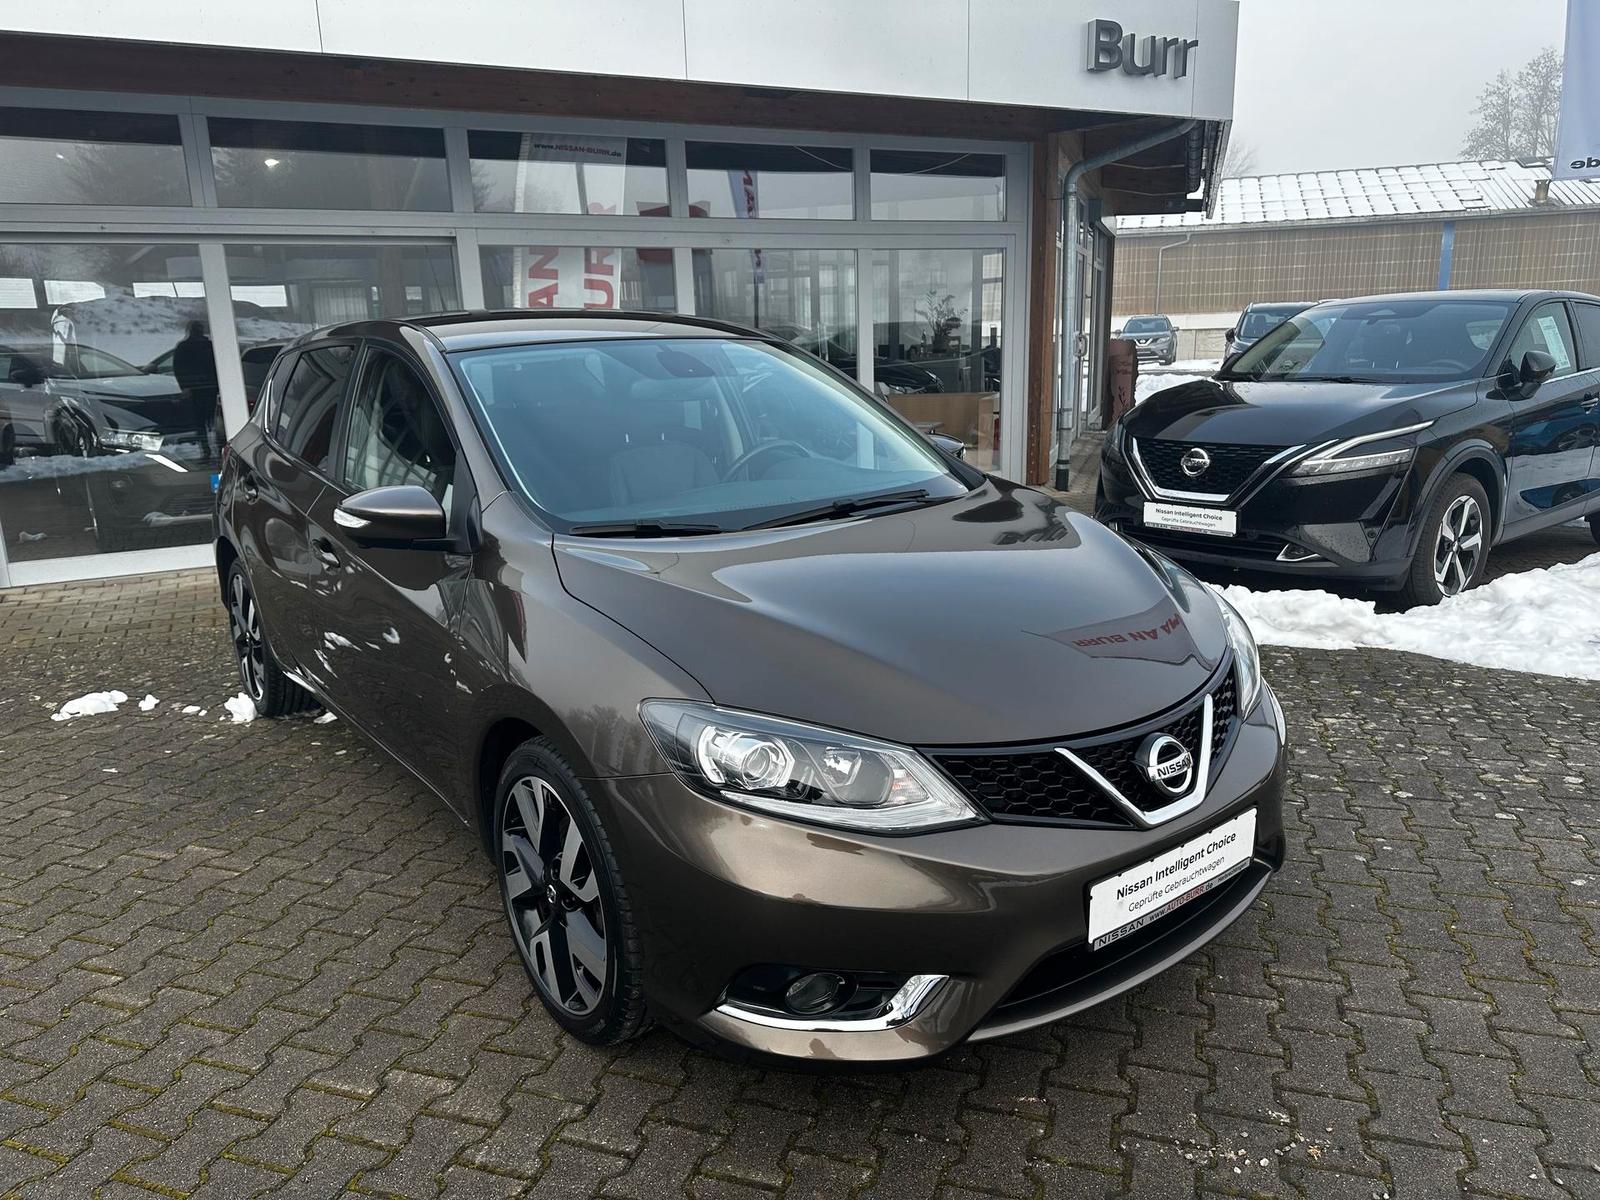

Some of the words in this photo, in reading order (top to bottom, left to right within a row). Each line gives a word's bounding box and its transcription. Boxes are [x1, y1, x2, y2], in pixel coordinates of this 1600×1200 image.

[1087, 18, 1199, 79] Burr
[1174, 510, 1202, 519] Intelligent
[1203, 513, 1223, 521] Choice
[1157, 753, 1192, 778] NISSAN
[1116, 875, 1153, 900] Nissan
[1155, 848, 1205, 882] Intelligent
[1206, 832, 1237, 855] Choice
[1128, 888, 1163, 912] Geprüfte
[1164, 856, 1225, 894] Gebrauchtwagen
[1099, 918, 1145, 946] NISSAN
[1149, 882, 1214, 921] www.AUTO-BURR.de
